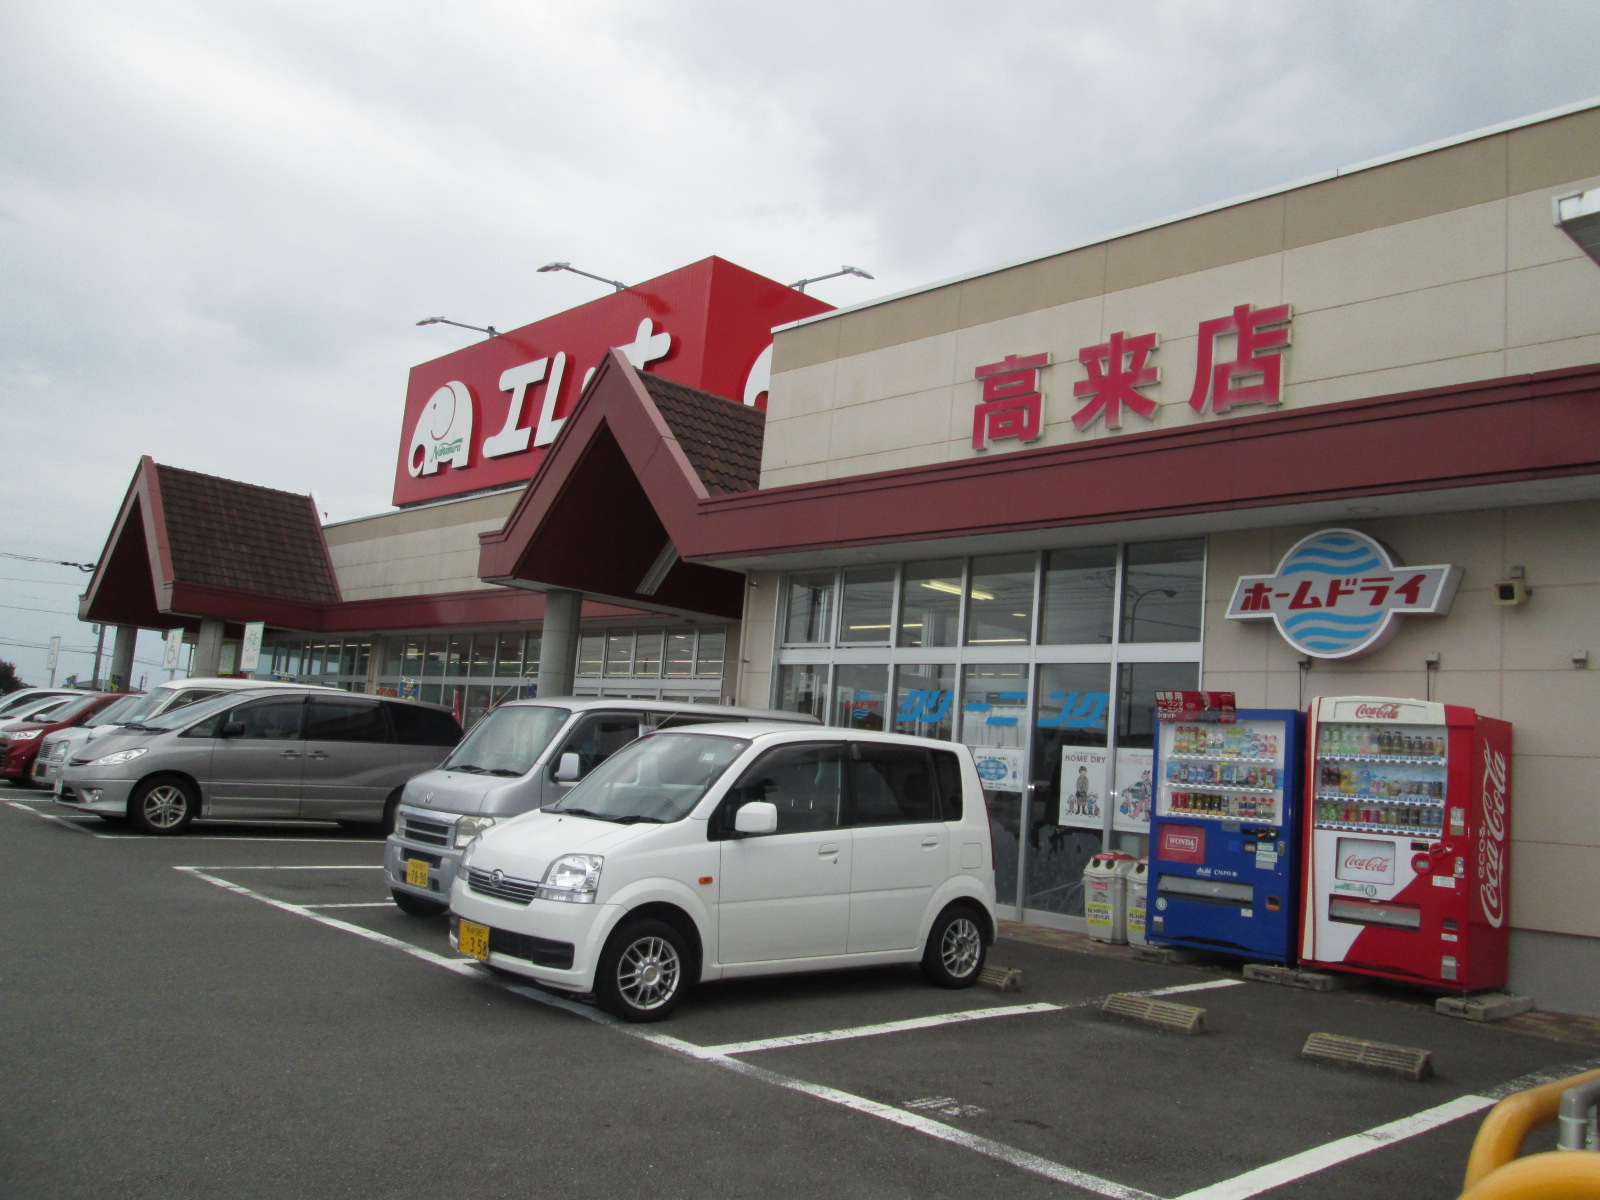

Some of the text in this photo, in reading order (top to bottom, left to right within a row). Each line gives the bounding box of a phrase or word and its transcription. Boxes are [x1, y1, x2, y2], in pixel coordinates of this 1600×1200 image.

[972, 303, 1293, 452] 高来店
[1240, 574, 1427, 610] ホームドライ
[896, 690, 1111, 728] クリーニング
[1355, 703, 1401, 719] Coca-Cola
[1065, 754, 1107, 764] HOME DRY
[1168, 836, 1195, 847] WONDA
[1480, 738, 1507, 928] Coca-Cola
[1344, 854, 1390, 873] Coca-Cola
